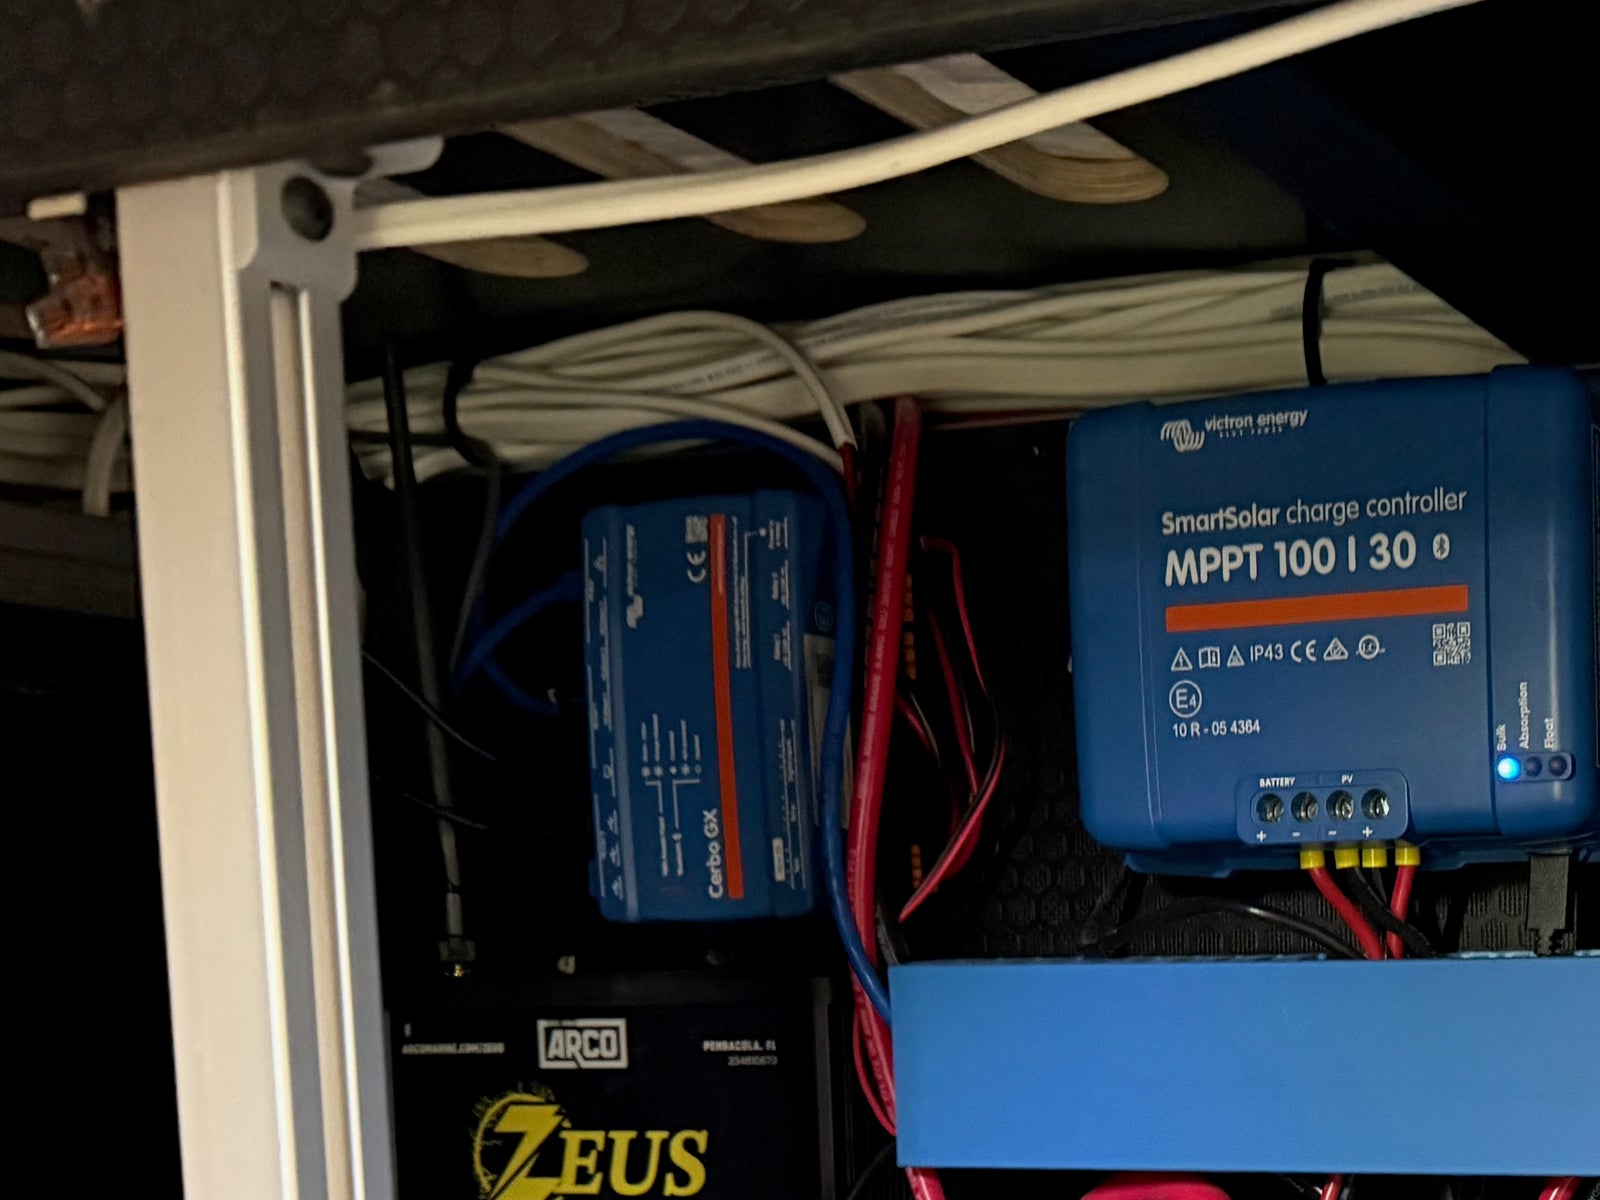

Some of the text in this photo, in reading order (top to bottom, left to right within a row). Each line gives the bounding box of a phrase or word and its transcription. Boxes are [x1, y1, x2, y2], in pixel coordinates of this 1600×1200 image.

[1204, 408, 1309, 432] victron energy
[1162, 486, 1468, 536] SmartSolar charge controller
[1165, 543, 1264, 587] MPPT
[1274, 536, 1336, 578] 100
[1369, 530, 1417, 571] 30
[1250, 643, 1284, 663] IP43
[1172, 722, 1188, 738] 10
[1518, 681, 1531, 750] Absorption
[1544, 717, 1556, 749] Float
[1259, 775, 1296, 788] BATTERY
[1341, 773, 1354, 784] PV
[701, 807, 724, 899] Cerbo GX
[547, 1029, 617, 1060] ARCO
